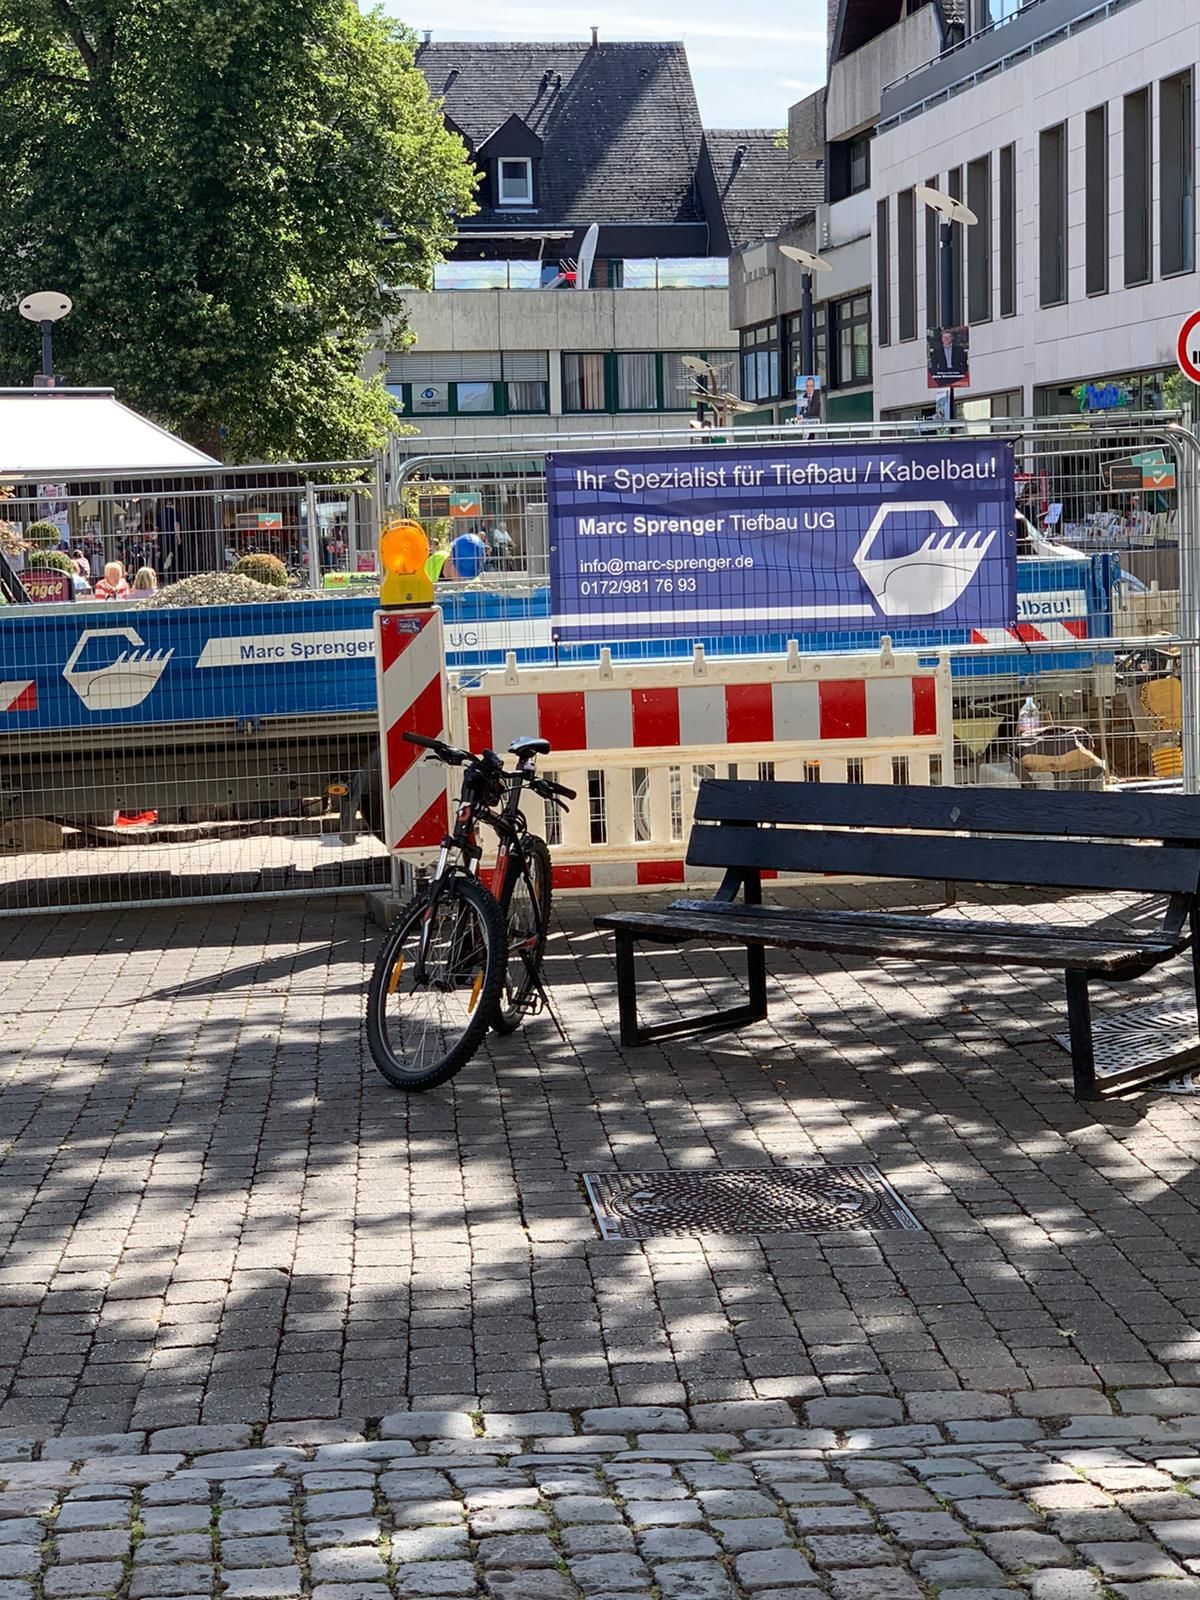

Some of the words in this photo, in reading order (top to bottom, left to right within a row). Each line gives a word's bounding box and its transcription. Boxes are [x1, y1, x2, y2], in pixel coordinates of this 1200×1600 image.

[576, 469, 607, 490] Ihr
[614, 466, 727, 493] Spezialist
[732, 465, 765, 486] für
[770, 463, 857, 486] Tiefbau
[863, 461, 872, 482] /
[880, 457, 997, 482] Kabelbau!
[579, 518, 628, 536] Marc
[633, 516, 725, 537] Sprenger
[729, 513, 798, 531] Tiefbau
[804, 512, 835, 529] UG
[580, 555, 754, 576] info@marc-sprenger.de
[23, 581, 63, 599] Engel
[580, 578, 649, 596] 0172/981
[655, 578, 674, 593] 76
[678, 577, 697, 592] 93
[240, 644, 285, 660] Marc
[291, 640, 375, 659] Sprenger
[449, 631, 479, 647] UG
